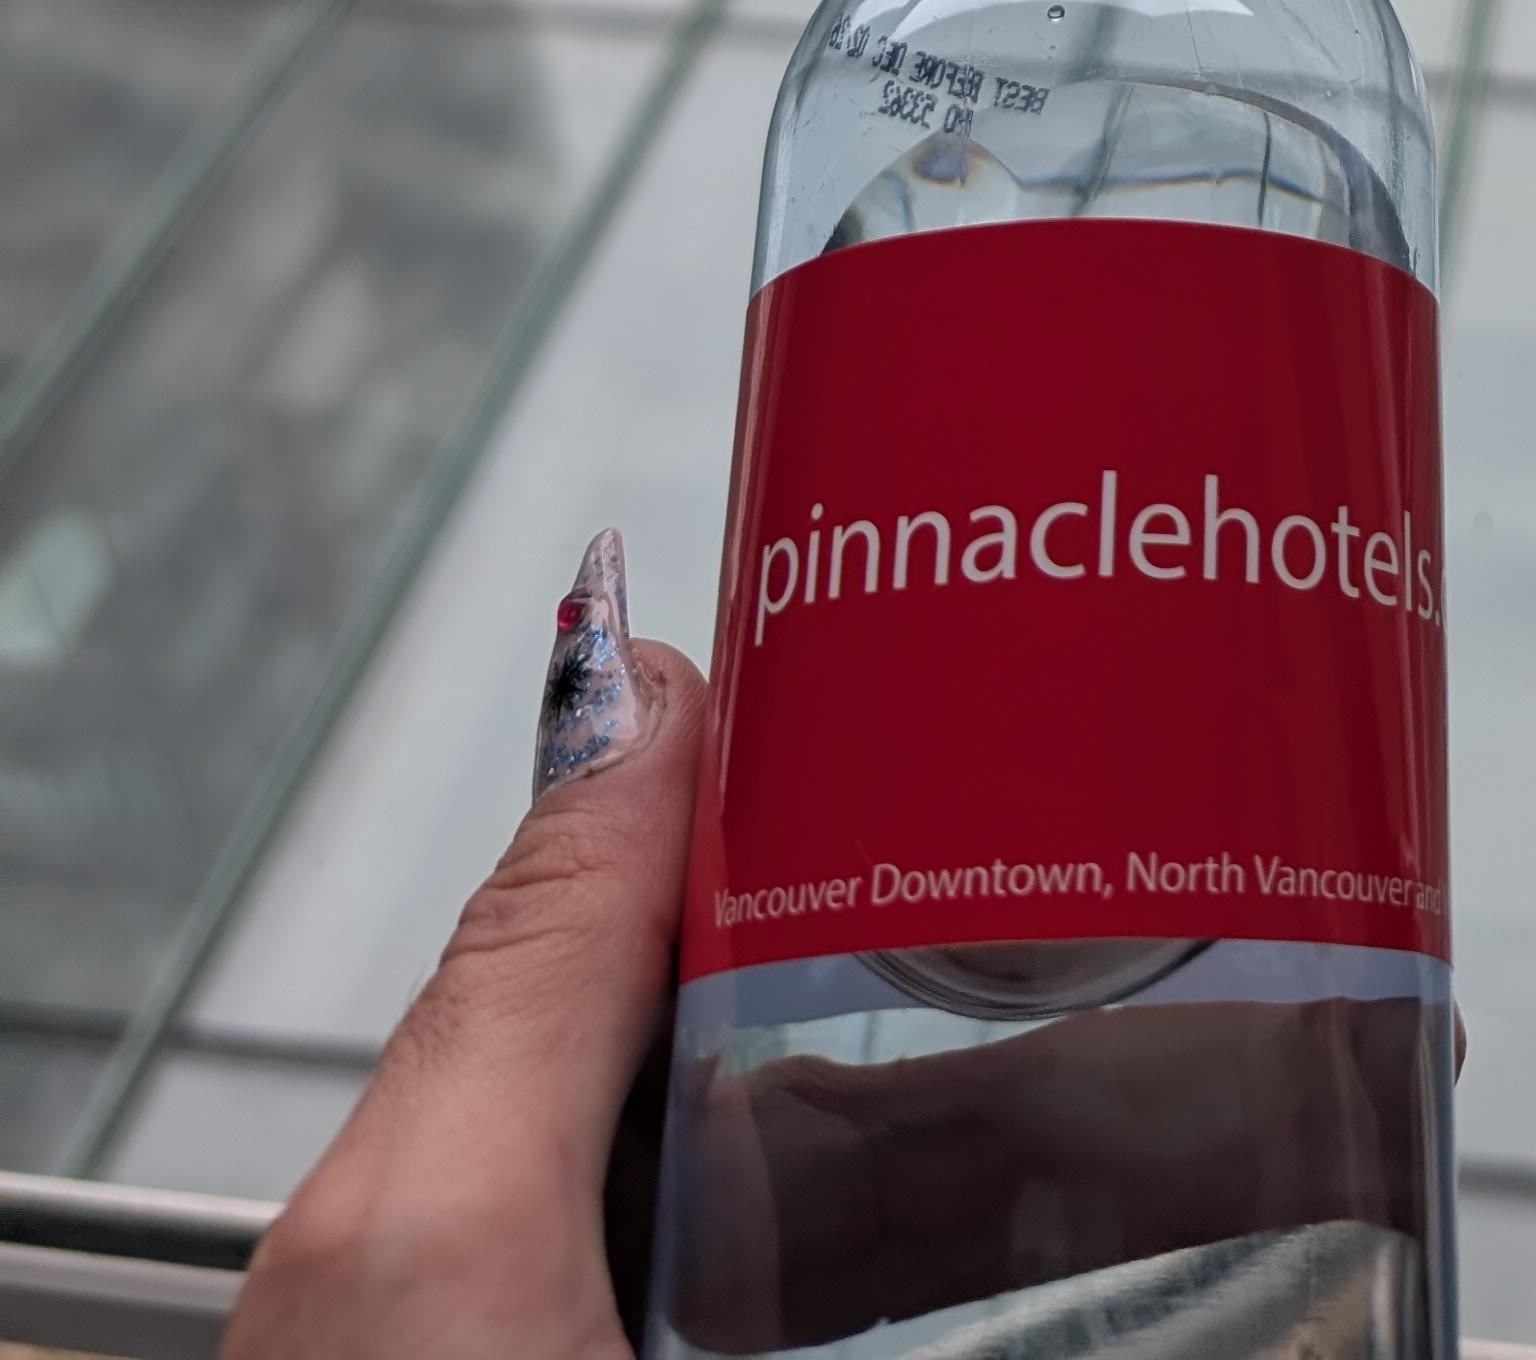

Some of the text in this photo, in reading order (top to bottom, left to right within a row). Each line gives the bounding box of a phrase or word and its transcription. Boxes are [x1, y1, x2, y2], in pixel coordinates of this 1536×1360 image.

[713, 874, 863, 928] Vancouver
[870, 857, 1114, 905] Downtown,
[1126, 850, 1246, 896] North
[1252, 853, 1412, 907] Vancouver
